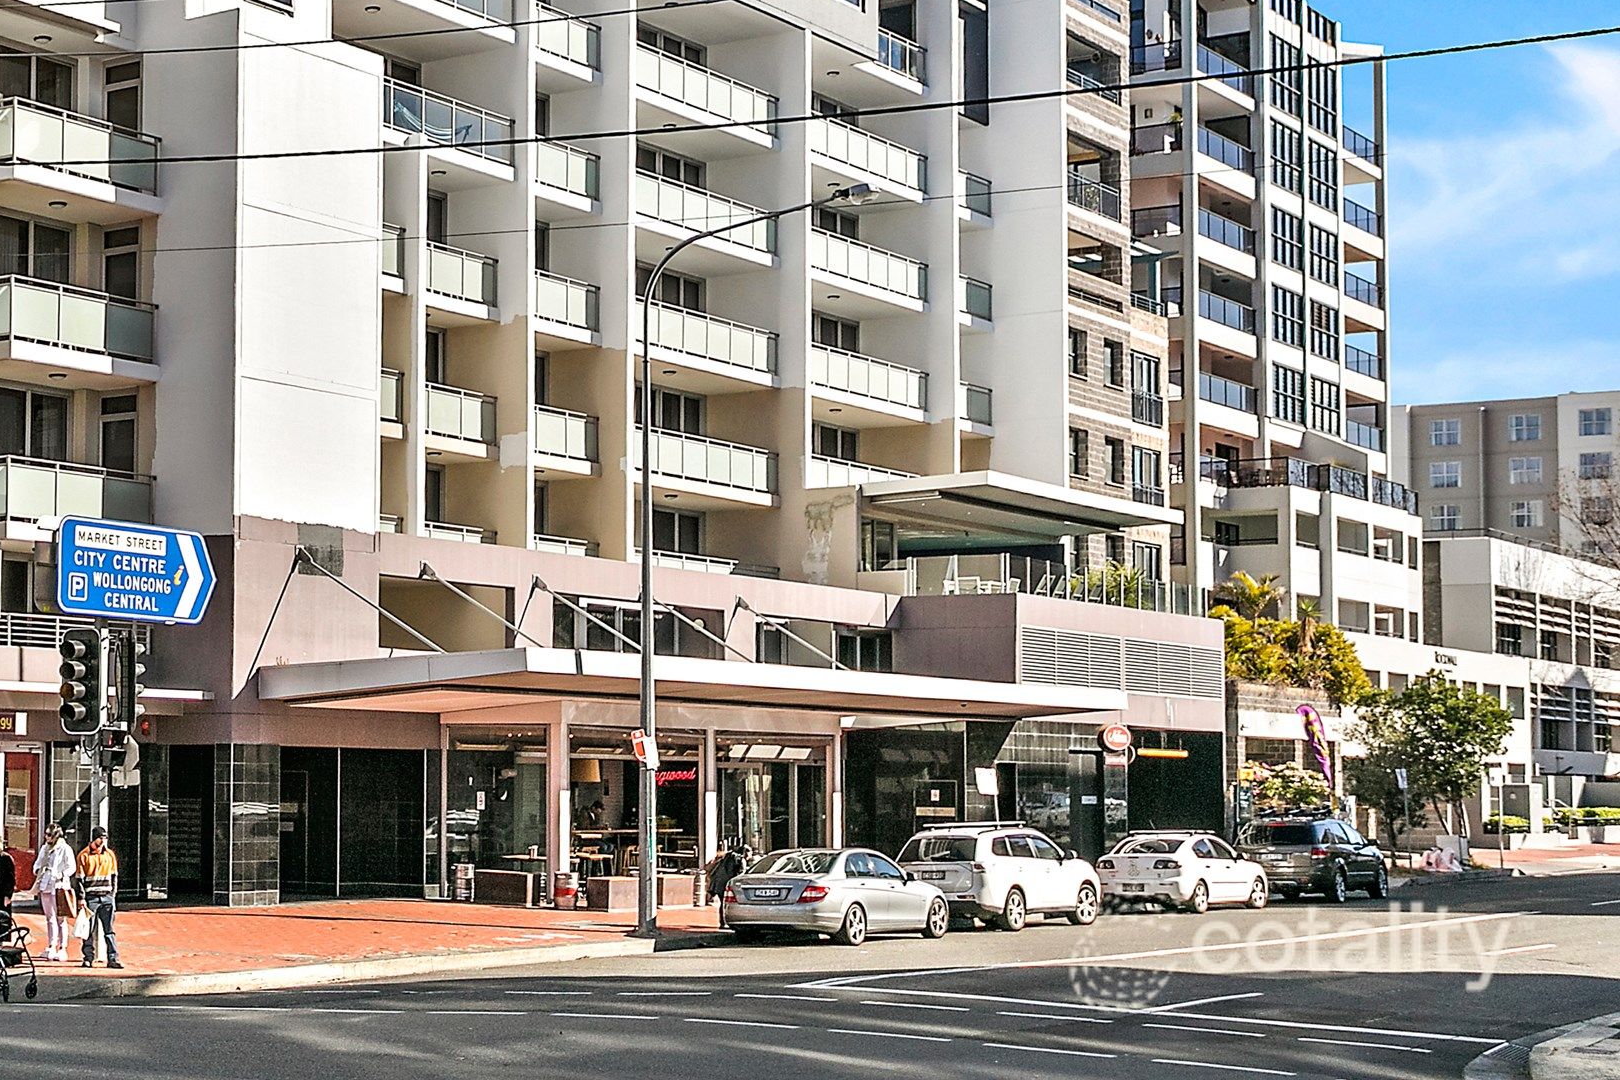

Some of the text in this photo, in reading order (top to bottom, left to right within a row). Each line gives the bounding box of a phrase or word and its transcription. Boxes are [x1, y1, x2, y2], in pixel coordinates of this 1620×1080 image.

[78, 531, 163, 551] MARKET STREET
[74, 550, 167, 575] CITY CENTRE
[93, 572, 171, 594] WOLLONGONG
[104, 592, 159, 612] CENTRAL
